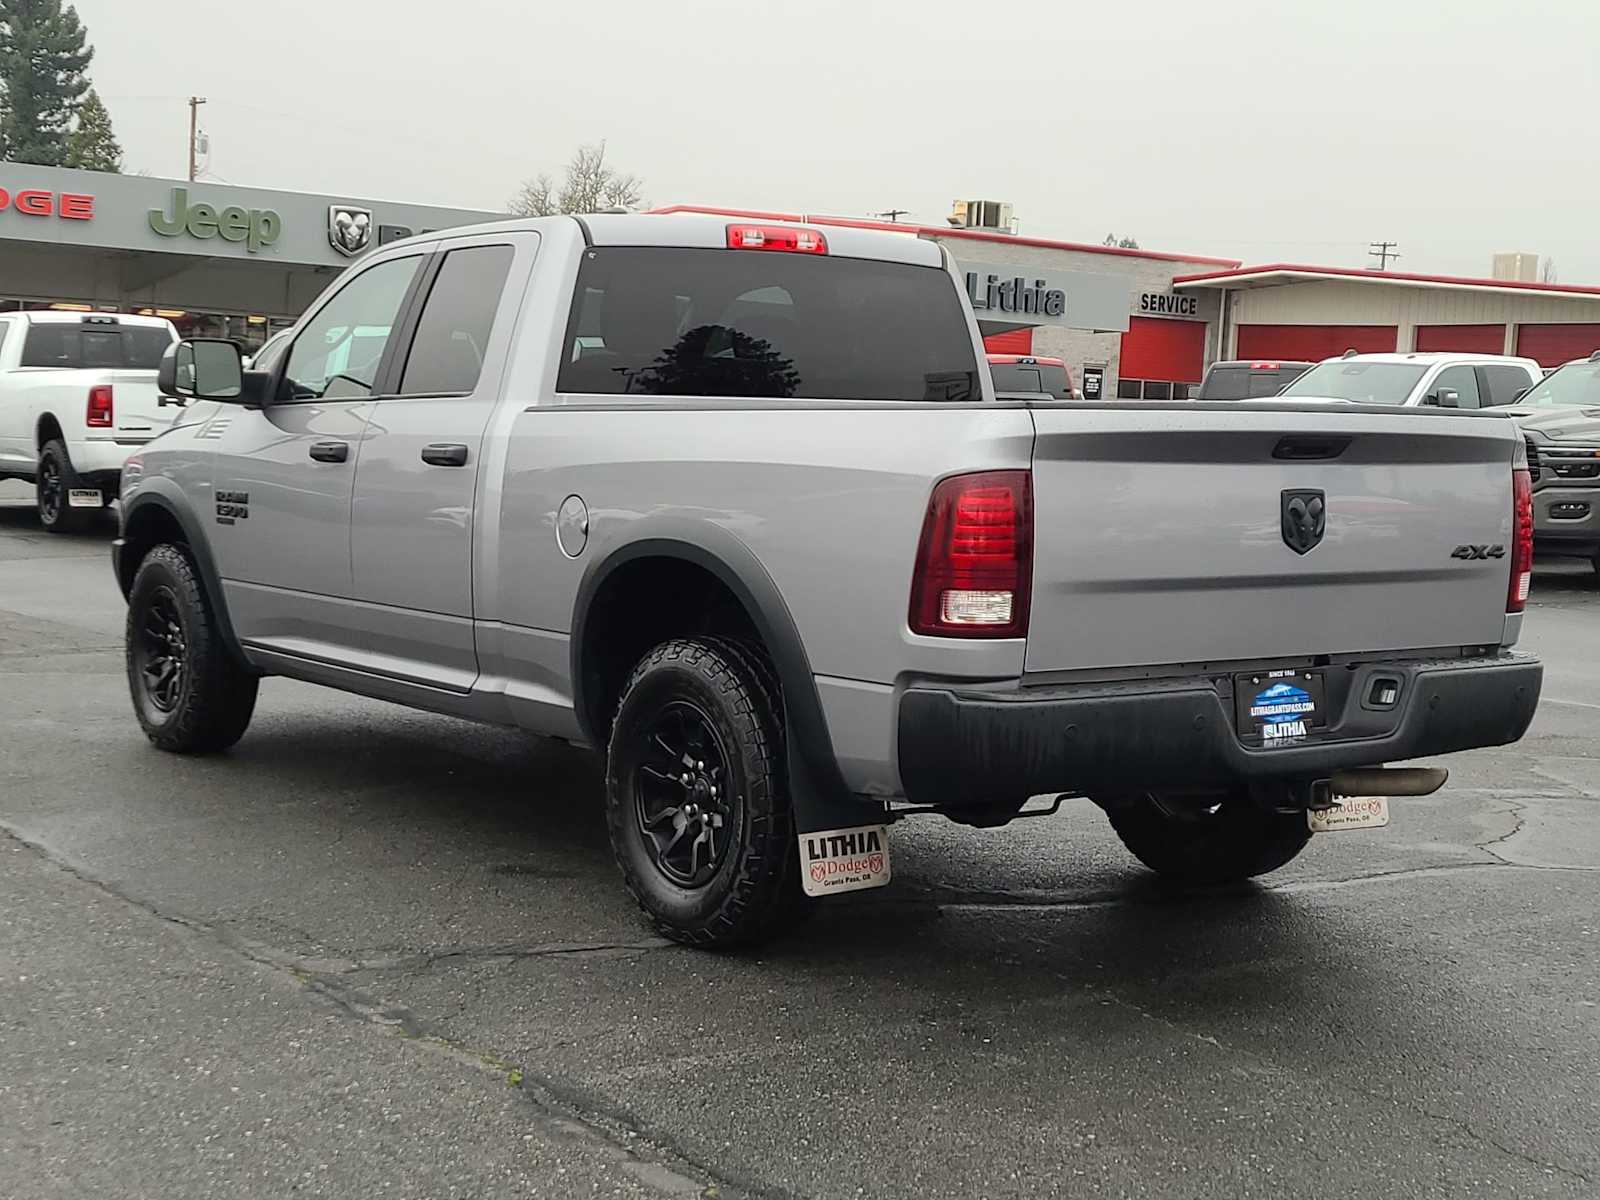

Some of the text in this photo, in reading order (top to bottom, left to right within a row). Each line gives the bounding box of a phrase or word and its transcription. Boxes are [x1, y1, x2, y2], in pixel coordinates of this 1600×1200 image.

[0, 187, 96, 220] GE
[148, 187, 281, 253] Jeep
[966, 272, 1065, 316] Lithia
[1141, 293, 1197, 315] SERVICE
[1274, 721, 1307, 738] LITHIA
[808, 831, 881, 861] LITHIA
[827, 858, 869, 875] Dodge
